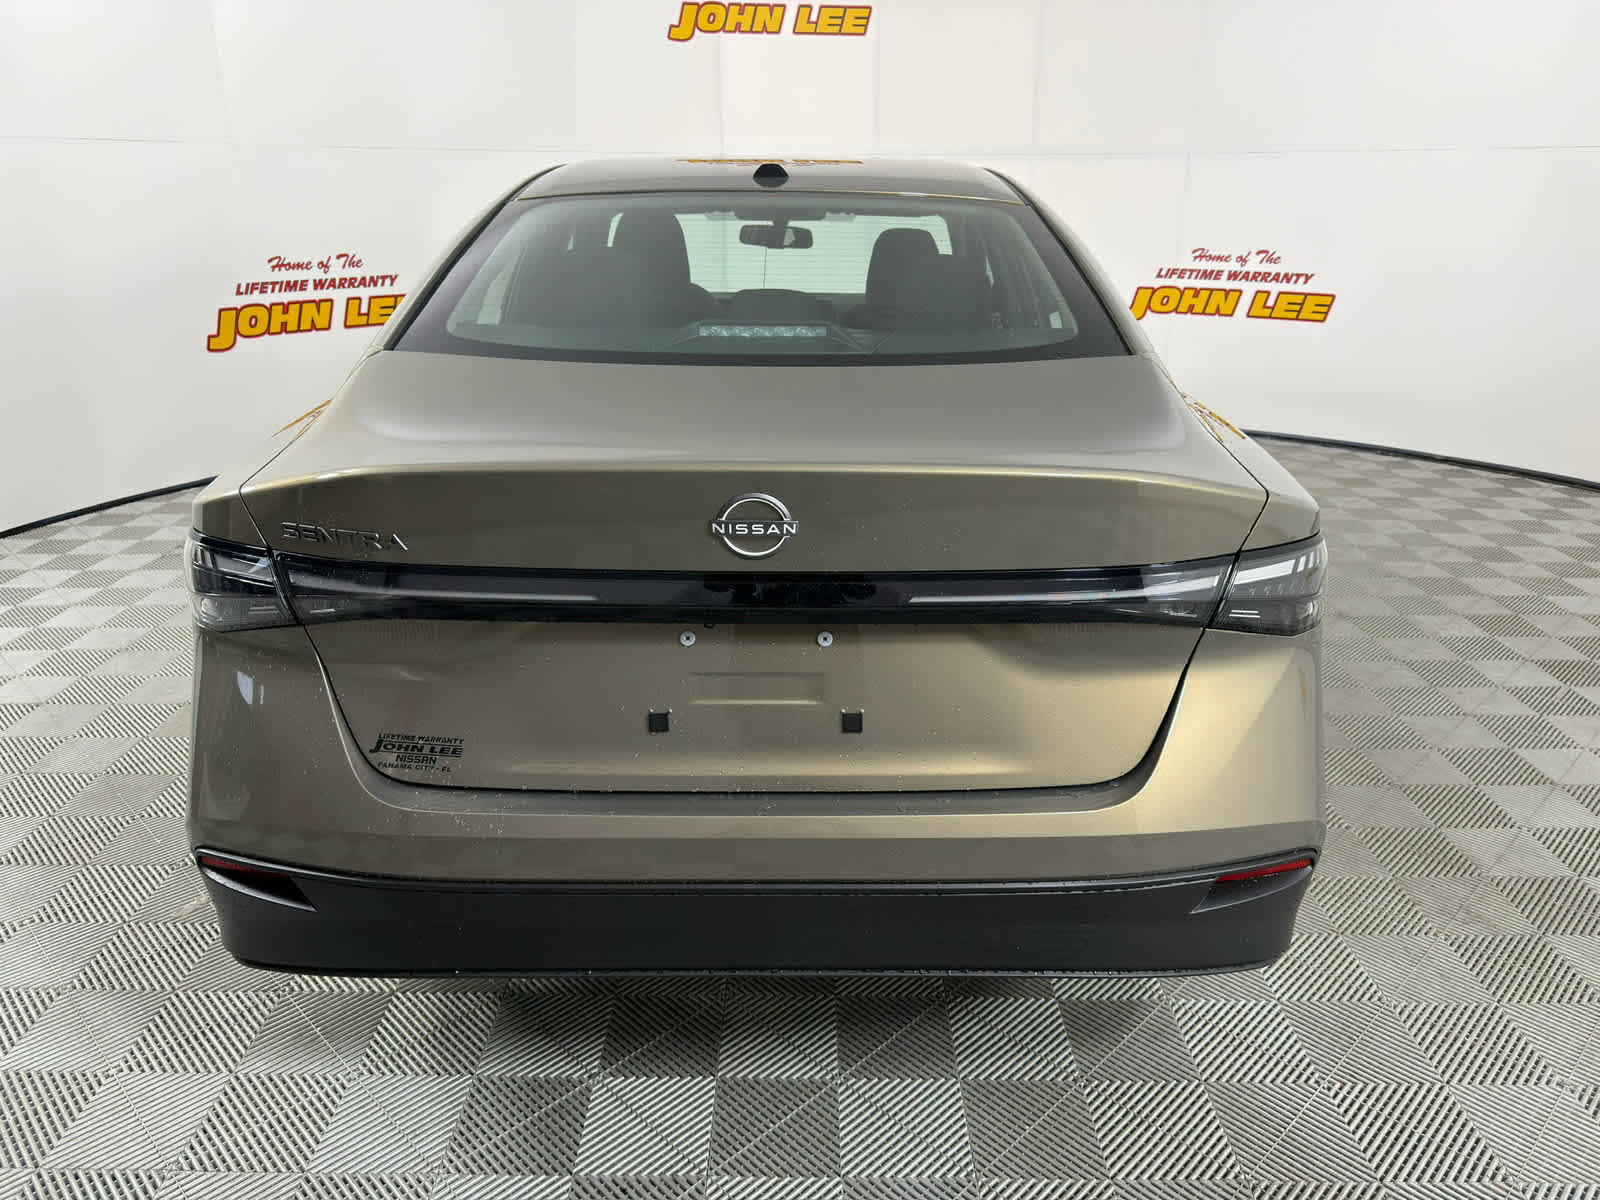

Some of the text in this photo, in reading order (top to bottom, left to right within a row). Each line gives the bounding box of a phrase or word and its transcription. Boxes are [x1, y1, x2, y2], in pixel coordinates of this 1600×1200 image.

[668, 2, 872, 41] JOHN LEE
[267, 255, 313, 272] Home
[336, 253, 363, 270] The
[1191, 248, 1232, 262] Home
[1256, 249, 1281, 265] The
[235, 274, 399, 296] LIFETIME WARRANTY
[1155, 267, 1315, 285] LIFETIME WARRANTY
[1129, 285, 1336, 323] JOHN LEE
[207, 294, 407, 353] JOHN LE
[281, 521, 409, 551] SENTRA
[711, 523, 797, 535] NISSAN
[369, 739, 464, 755] JOHN LEE
[378, 732, 464, 745] LIFETIME WARRANTY
[377, 761, 412, 770] PANAMA
[395, 754, 438, 765] NISSAN
